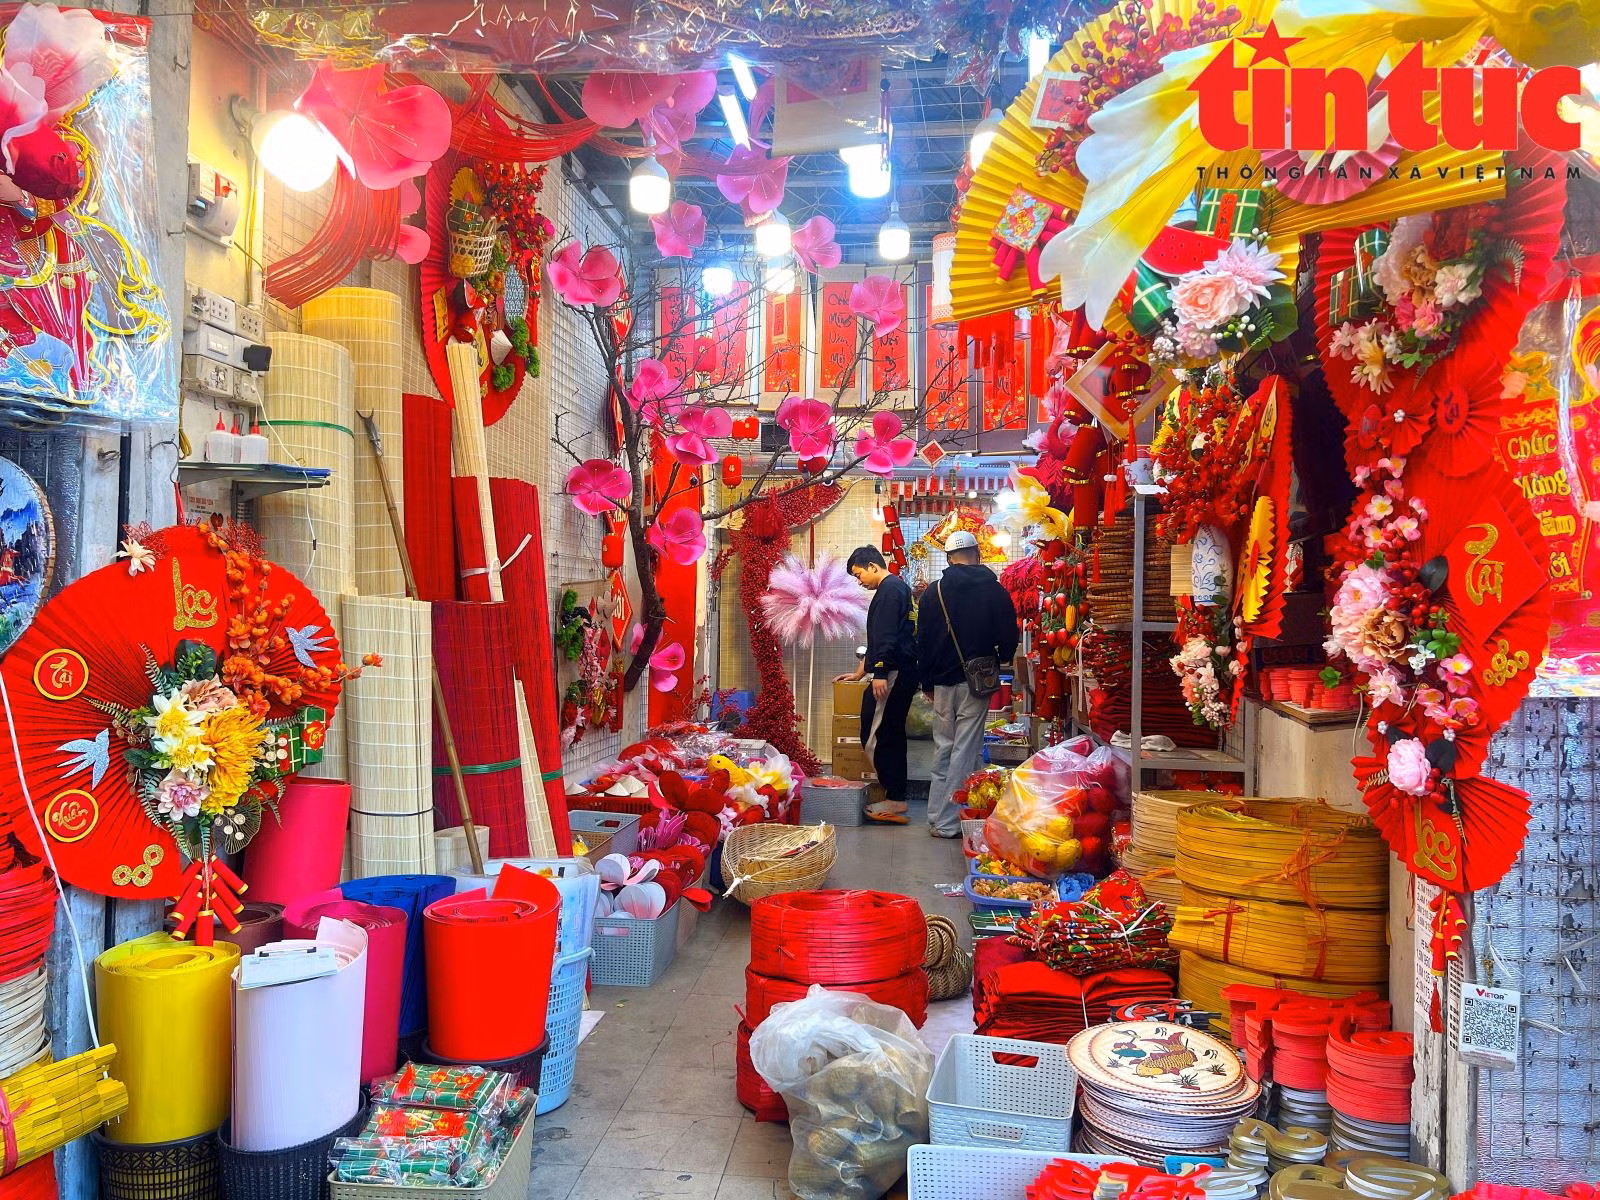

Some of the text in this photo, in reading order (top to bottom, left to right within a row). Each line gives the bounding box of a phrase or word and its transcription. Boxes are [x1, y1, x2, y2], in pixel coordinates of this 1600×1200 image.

[172, 556, 219, 631] Lộc
[50, 656, 73, 689] Tài
[1413, 796, 1458, 881] Lộc
